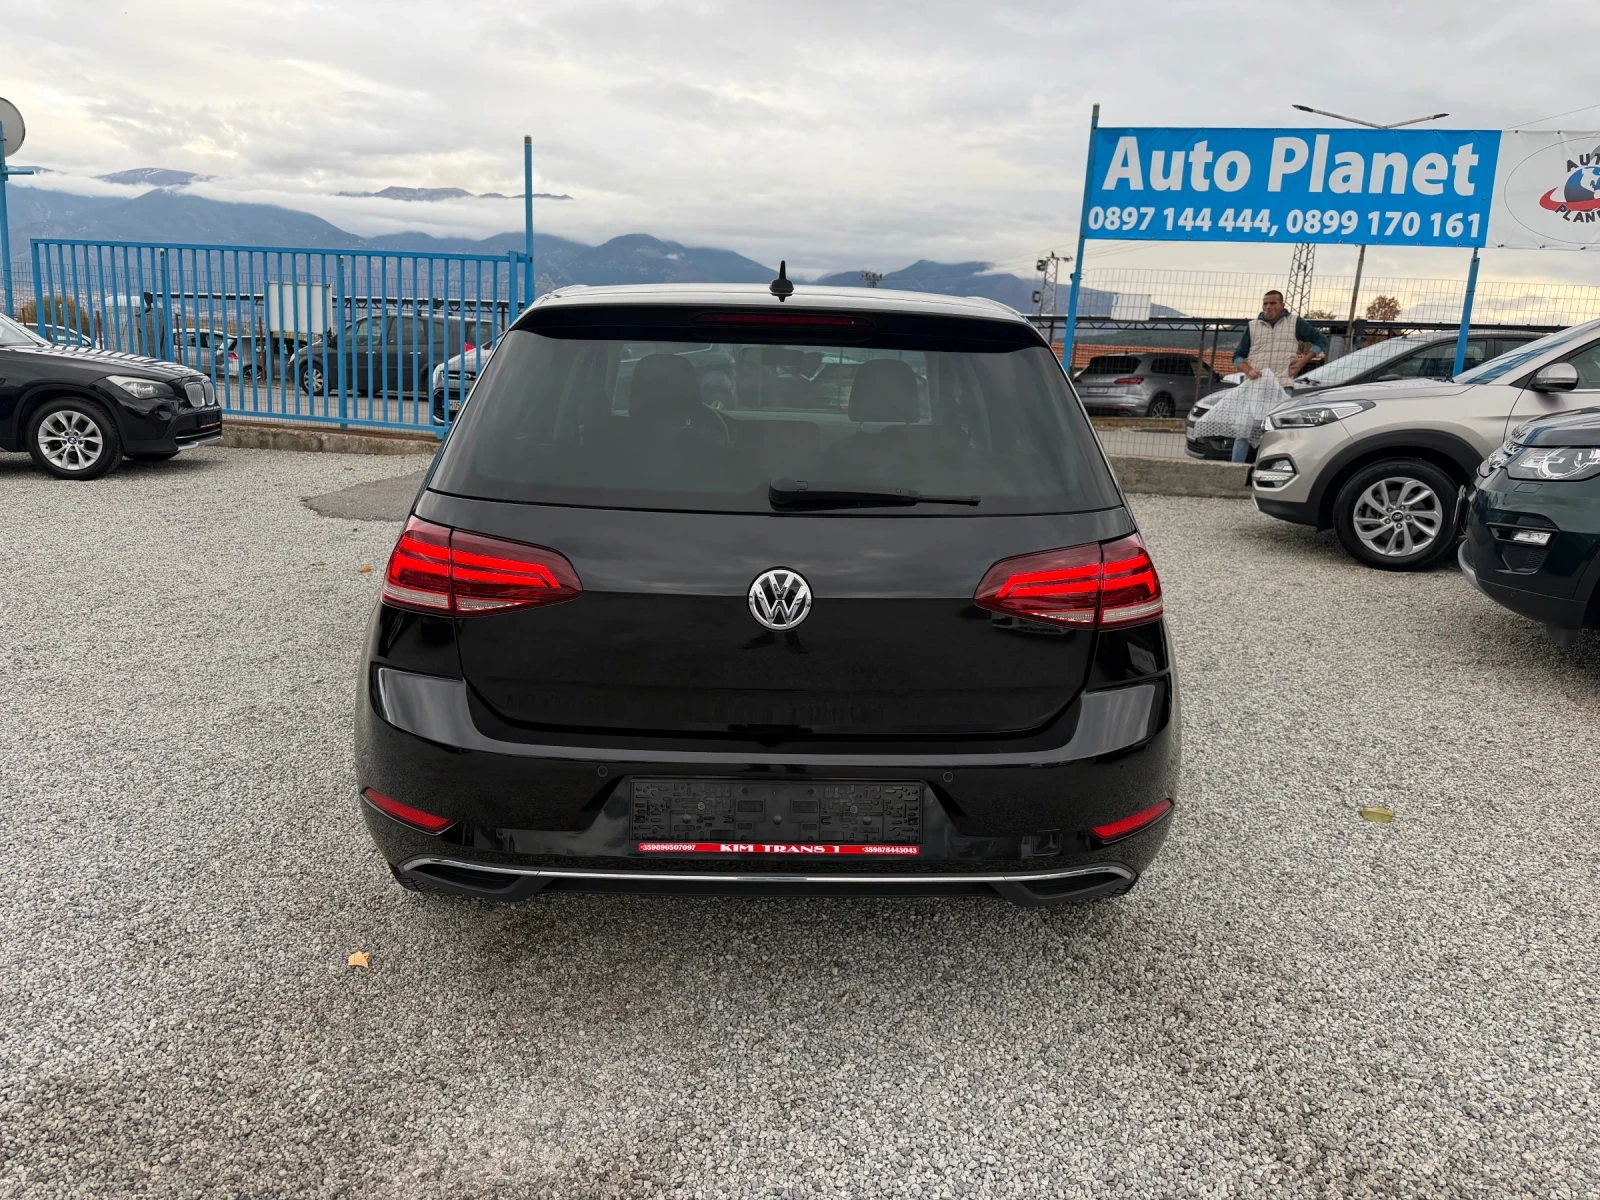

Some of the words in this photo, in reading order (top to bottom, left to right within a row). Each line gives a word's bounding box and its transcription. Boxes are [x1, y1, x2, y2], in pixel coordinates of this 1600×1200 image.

[1102, 136, 1251, 192] Auto
[1267, 134, 1479, 196] Planet
[1088, 206, 1155, 231] 0897
[1163, 207, 1212, 232] 144
[1218, 208, 1279, 237] 444,
[1286, 208, 1359, 235] 0899
[1367, 210, 1421, 236] 170
[1430, 212, 1480, 238] 161
[720, 844, 754, 852] KIM
[762, 845, 825, 853] TRANS
